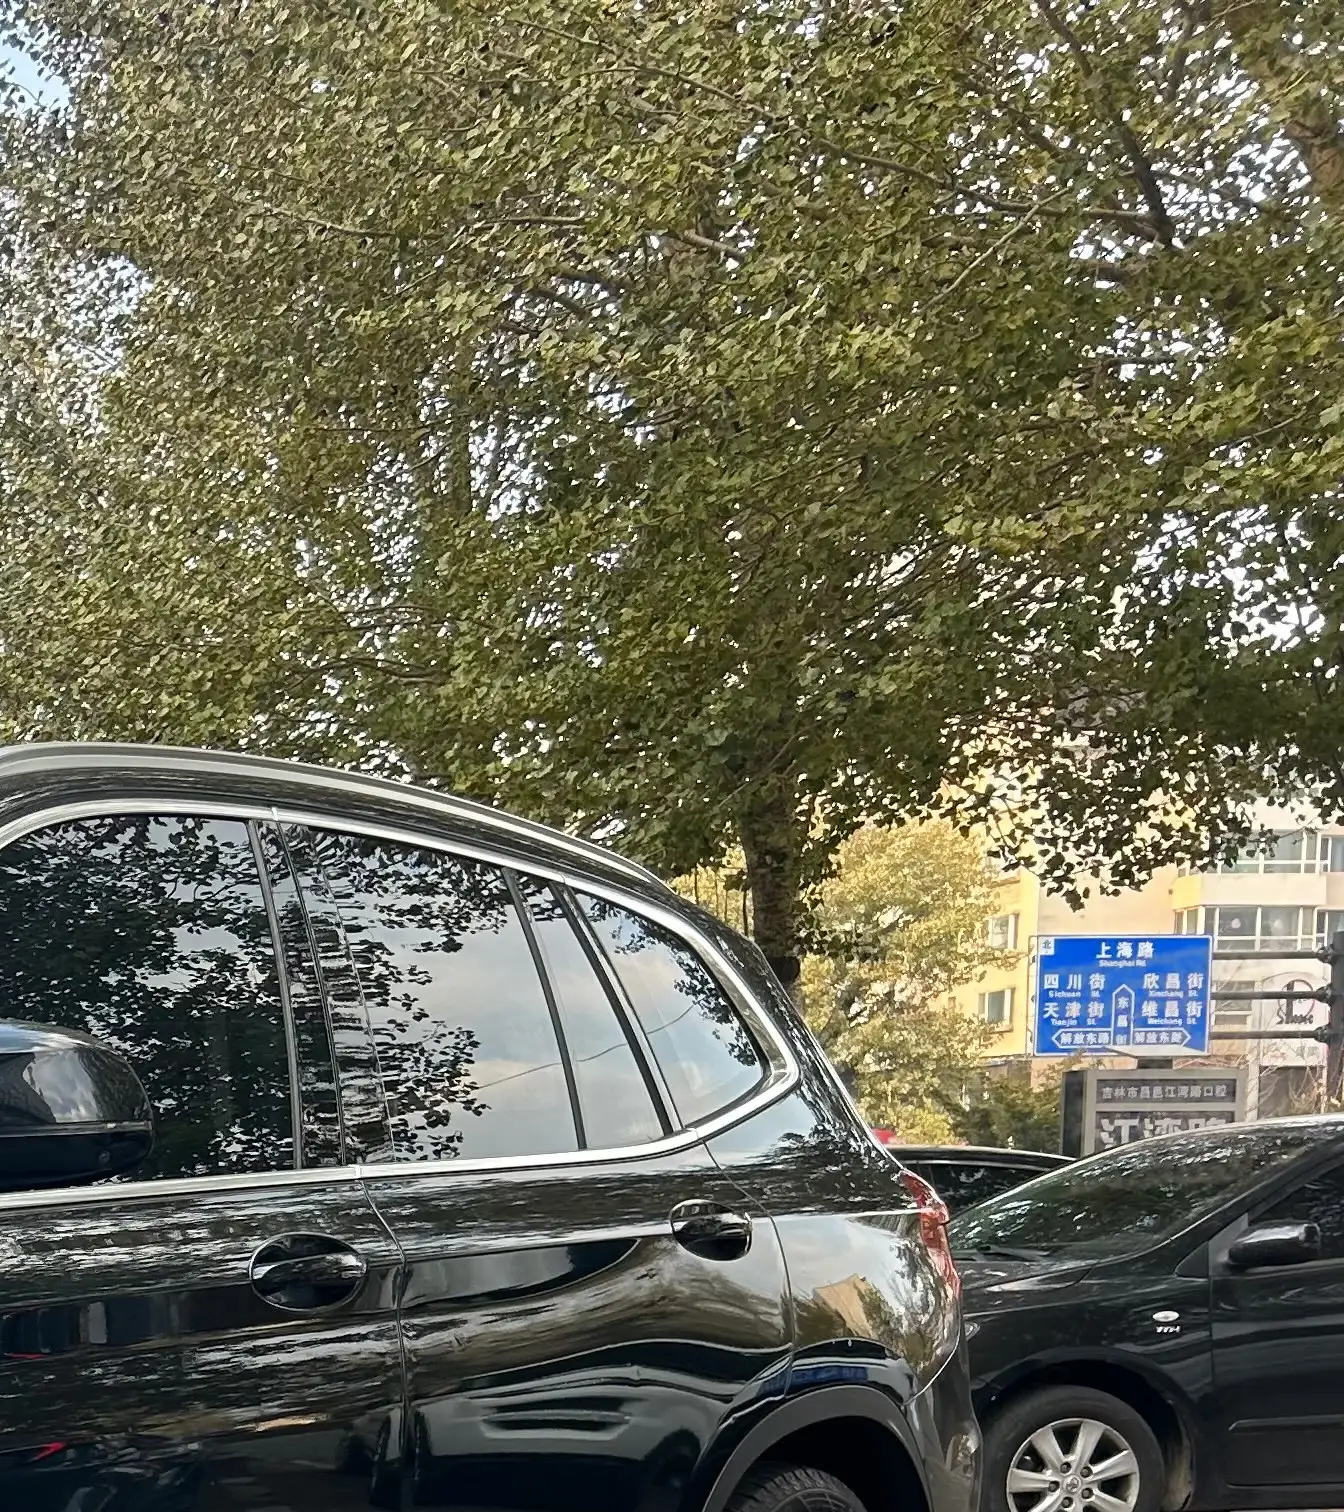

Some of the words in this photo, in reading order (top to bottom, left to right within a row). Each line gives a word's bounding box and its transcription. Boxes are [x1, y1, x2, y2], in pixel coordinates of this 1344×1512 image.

[1096, 941, 1155, 959] 上海路
[1044, 973, 1106, 990] 四川街
[1043, 1001, 1105, 1018] 天津街
